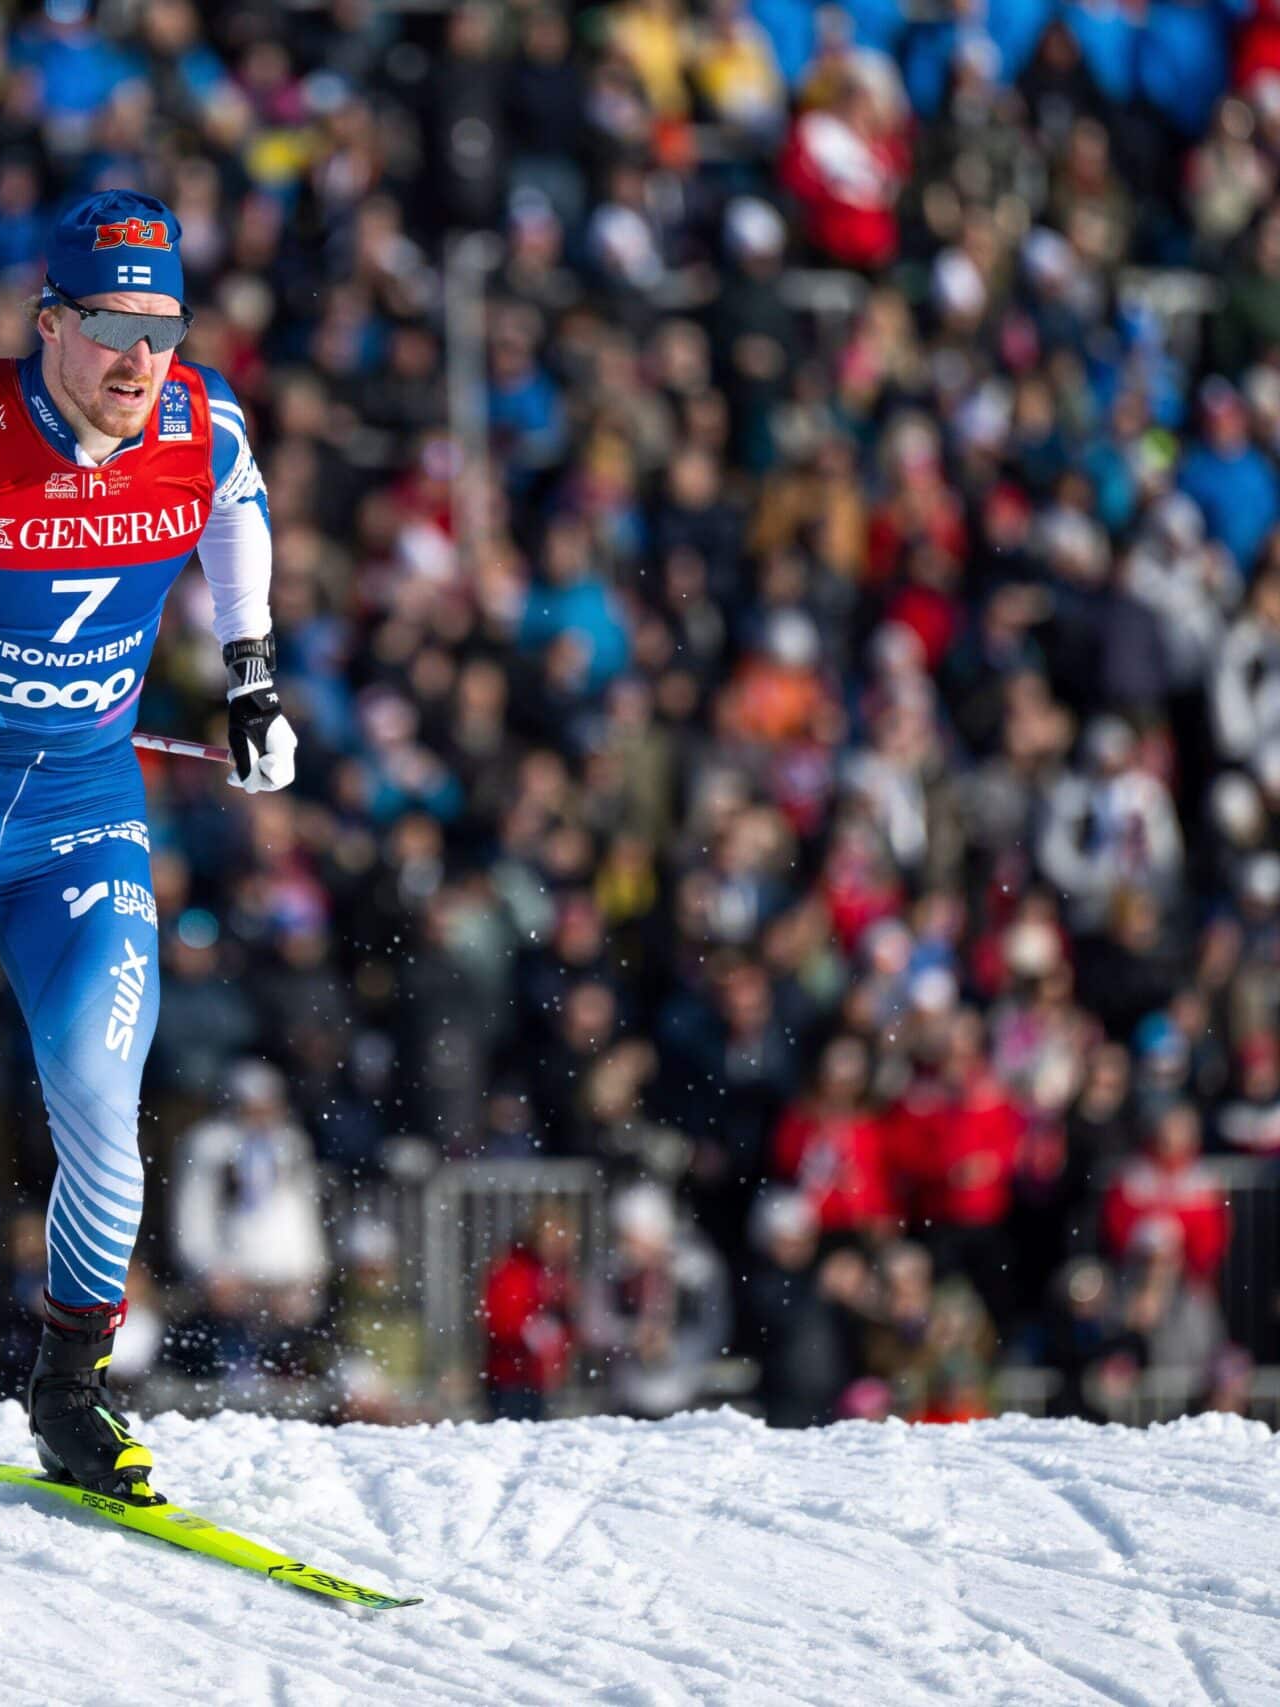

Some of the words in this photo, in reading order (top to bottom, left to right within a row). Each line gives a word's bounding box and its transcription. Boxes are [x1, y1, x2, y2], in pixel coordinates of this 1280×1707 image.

[163, 424, 186, 432] 2025
[19, 499, 202, 549] GENERALI
[49, 577, 120, 644] 7
[81, 1493, 125, 1517] FISCHER
